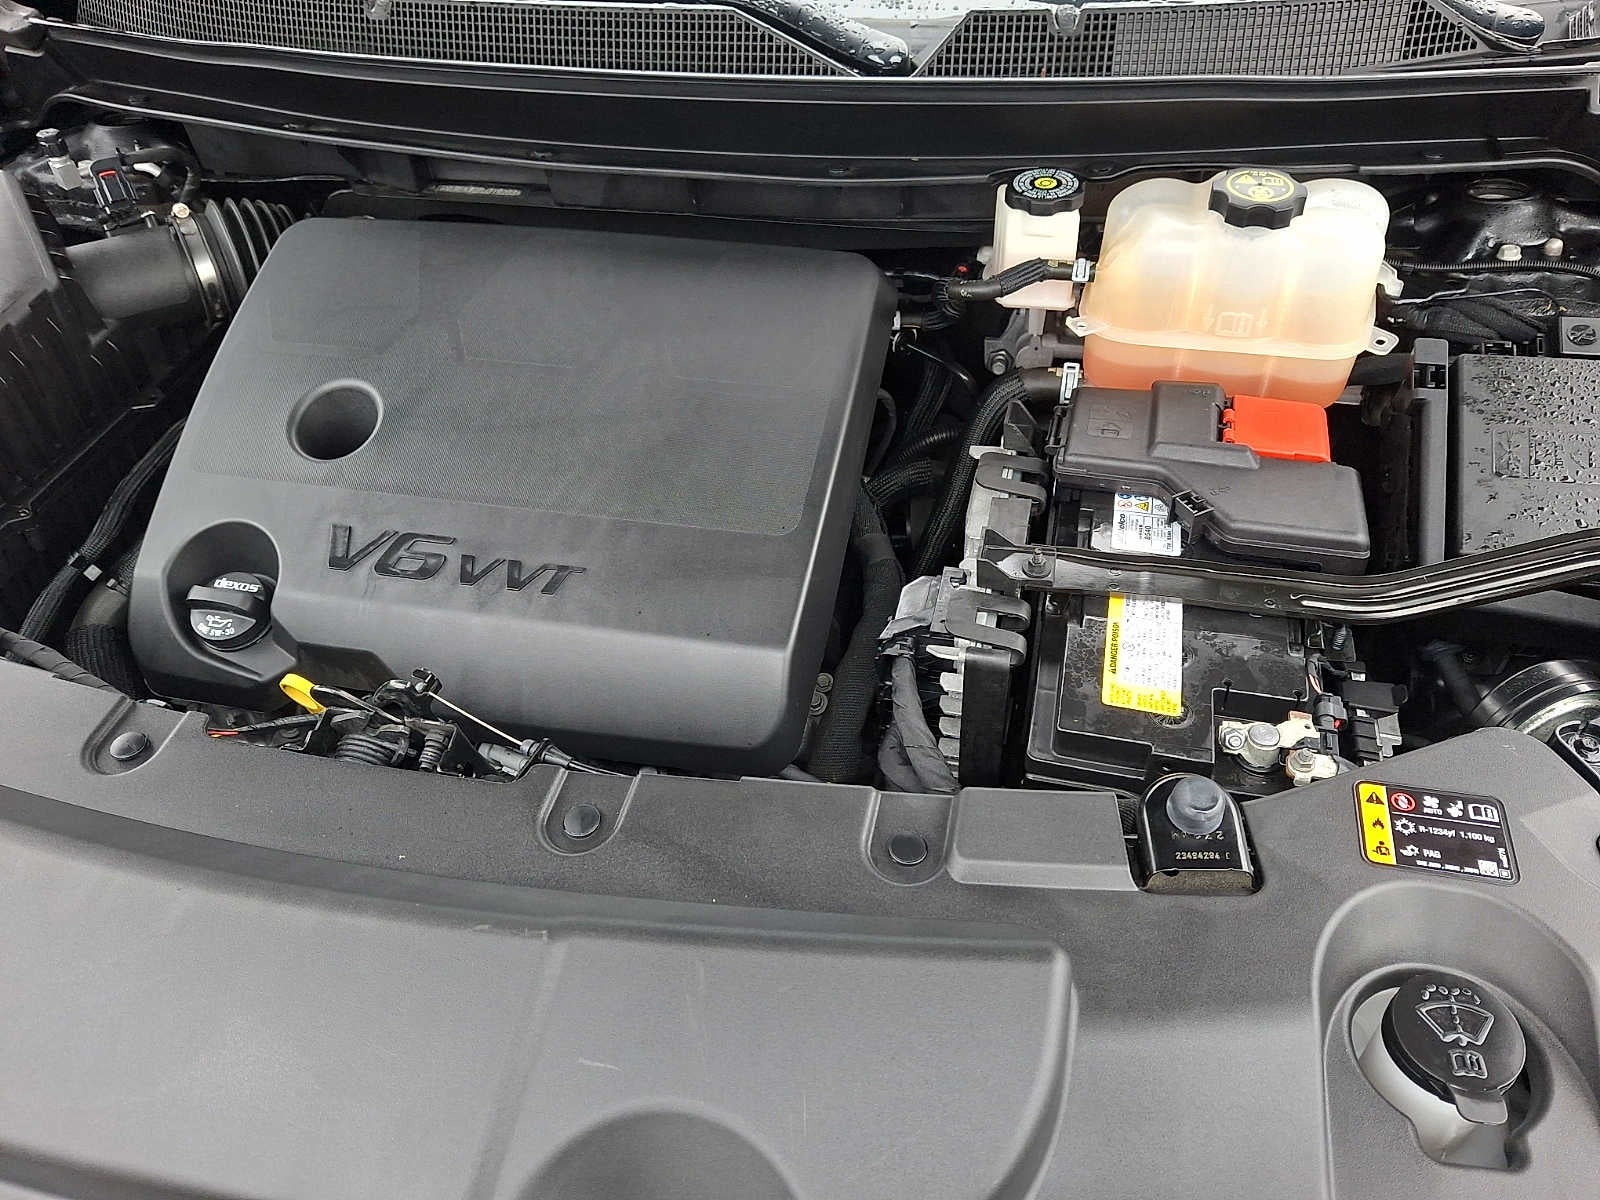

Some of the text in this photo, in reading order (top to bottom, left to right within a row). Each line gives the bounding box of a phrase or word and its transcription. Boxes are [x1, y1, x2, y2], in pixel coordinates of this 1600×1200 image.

[327, 523, 587, 595] V6 VVT
[213, 577, 261, 593] dexos
[1110, 643, 1119, 668] DANGER
